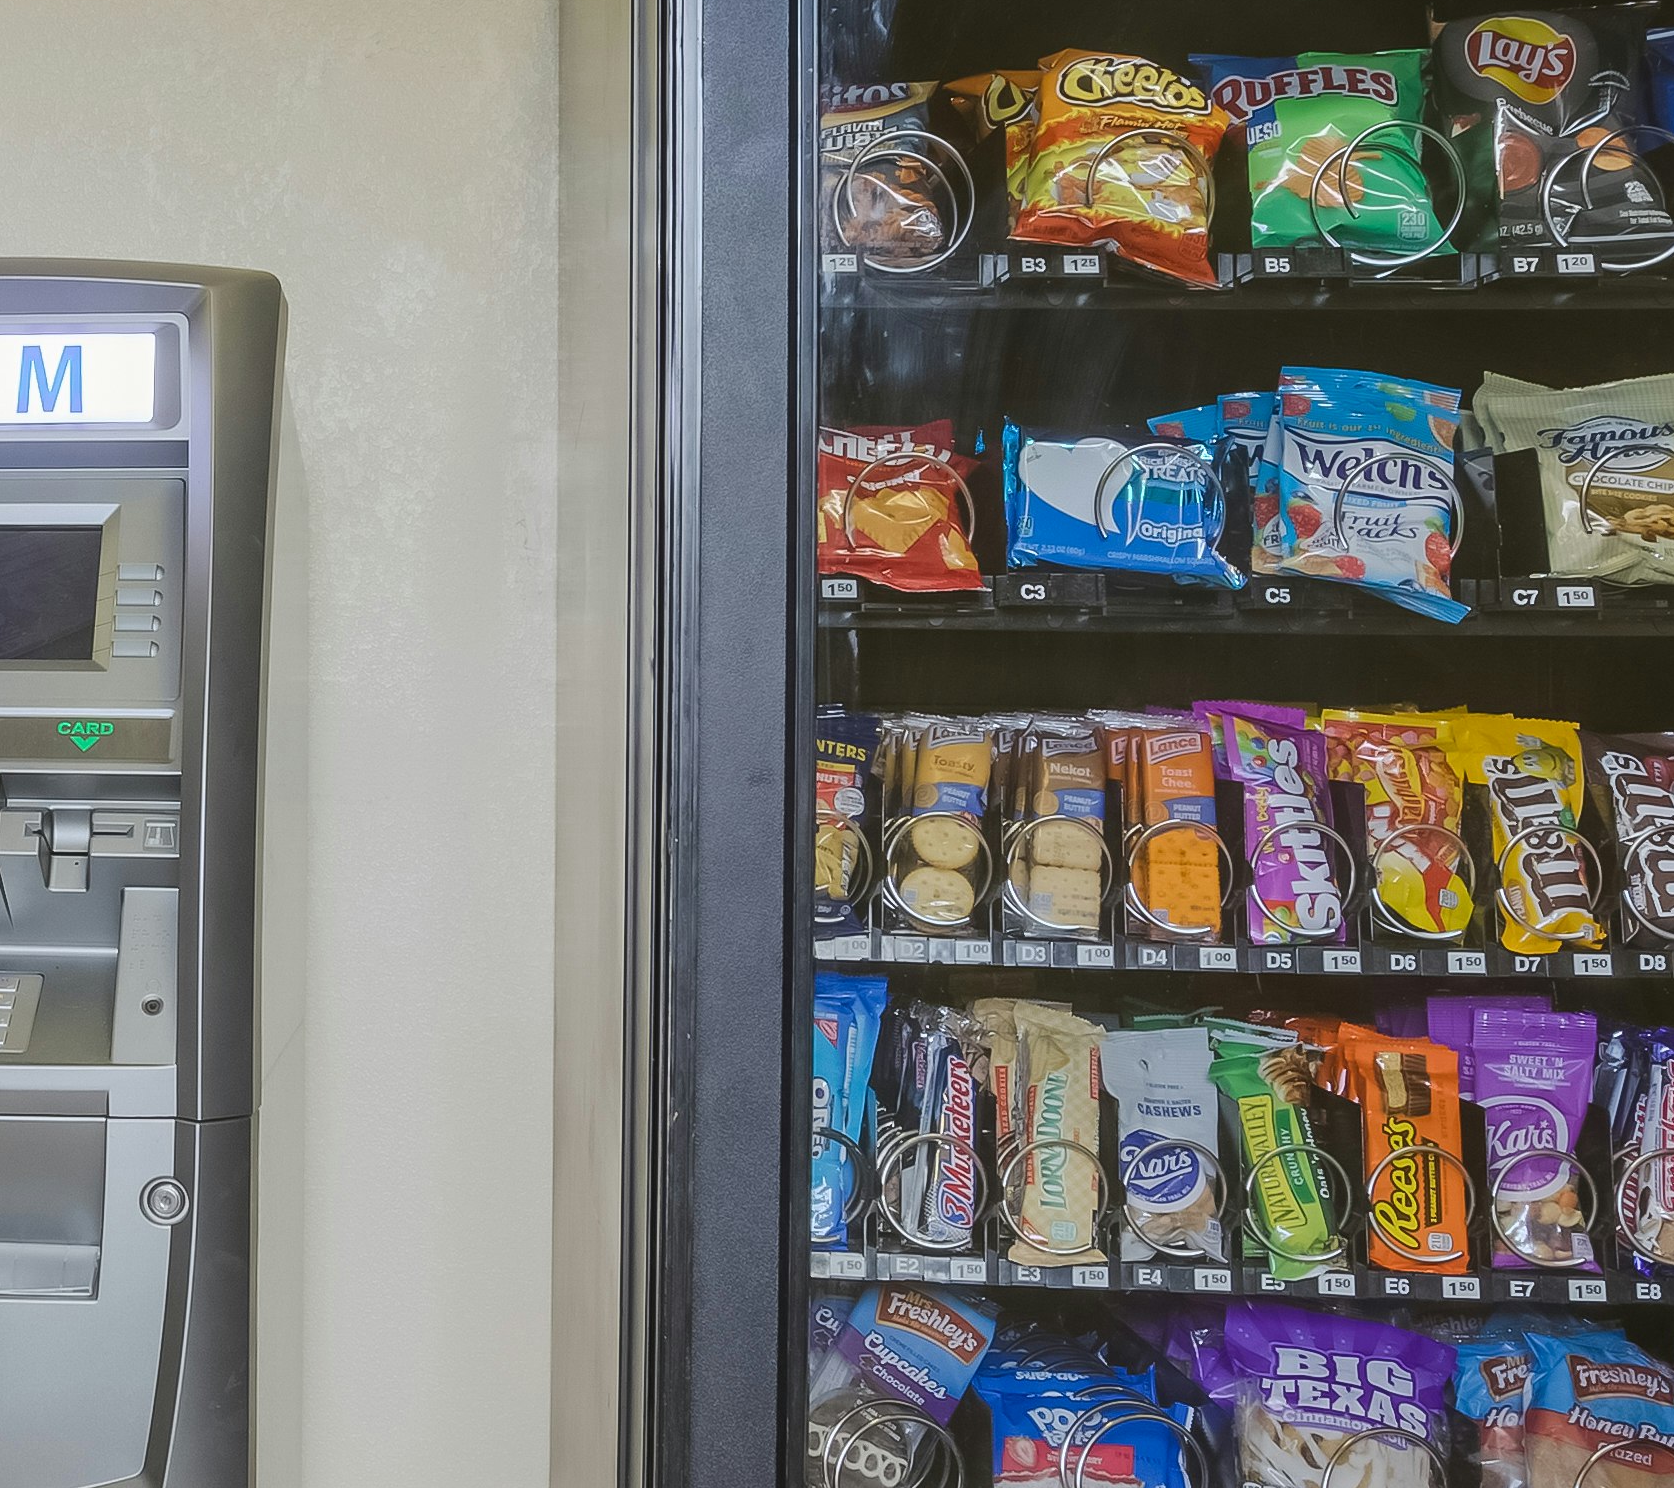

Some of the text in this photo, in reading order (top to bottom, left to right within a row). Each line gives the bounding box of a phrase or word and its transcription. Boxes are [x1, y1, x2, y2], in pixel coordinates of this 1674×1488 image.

[1479, 32, 1570, 80] Lay's
[1060, 58, 1207, 110] Cheetos
[1212, 67, 1397, 121] RUFFLES
[1402, 212, 1425, 227] 230
[1022, 256, 1047, 273] B3
[1265, 257, 1290, 274] B5
[1514, 257, 1539, 273] B7
[1537, 423, 1674, 449] Famous
[1142, 464, 1205, 486] TREATS
[1647, 480, 1674, 492] CHIP
[1020, 584, 1046, 600] C3
[1265, 588, 1291, 604] C5
[1513, 589, 1539, 605] C7
[56, 721, 115, 737] CARD
[1150, 735, 1199, 756] Lance
[934, 754, 975, 773] Toasty
[1050, 762, 1092, 777] Nekot
[1160, 765, 1193, 778] Toast
[1063, 794, 1092, 805] PEANUT
[1063, 803, 1092, 813] BUTTER
[1268, 737, 1341, 931] Skittles
[904, 942, 924, 958] D2
[1021, 946, 1047, 962] D3
[1142, 949, 1168, 965] D4
[1266, 953, 1292, 969] D5
[1390, 954, 1416, 970] D6
[1514, 956, 1541, 973] D7
[1639, 955, 1667, 972] D8
[1509, 1053, 1542, 1066] SWEET
[1504, 1065, 1566, 1081] SALTY MIX
[1137, 1102, 1202, 1118] CASHEWS
[1245, 1101, 1274, 1159] VALLEY
[1487, 1120, 1555, 1158] Kar's
[1374, 1115, 1421, 1250] Reese's
[944, 1196, 973, 1227] 3
[896, 1257, 919, 1273] E2
[1017, 1267, 1041, 1281] E3
[1138, 1269, 1162, 1285] E4
[1261, 1278, 1285, 1291] E5
[1384, 1279, 1410, 1296] E6
[1509, 1280, 1535, 1298] E7
[1636, 1283, 1662, 1300] E8
[888, 1292, 978, 1353] Freshley's
[863, 1331, 949, 1401] Cupcakes
[1274, 1346, 1414, 1396] BIG
[871, 1364, 926, 1407] Chocolate
[1576, 1361, 1671, 1395] Freshley's
[1260, 1379, 1428, 1439] TEXAS
[1571, 1405, 1634, 1440] Honey
